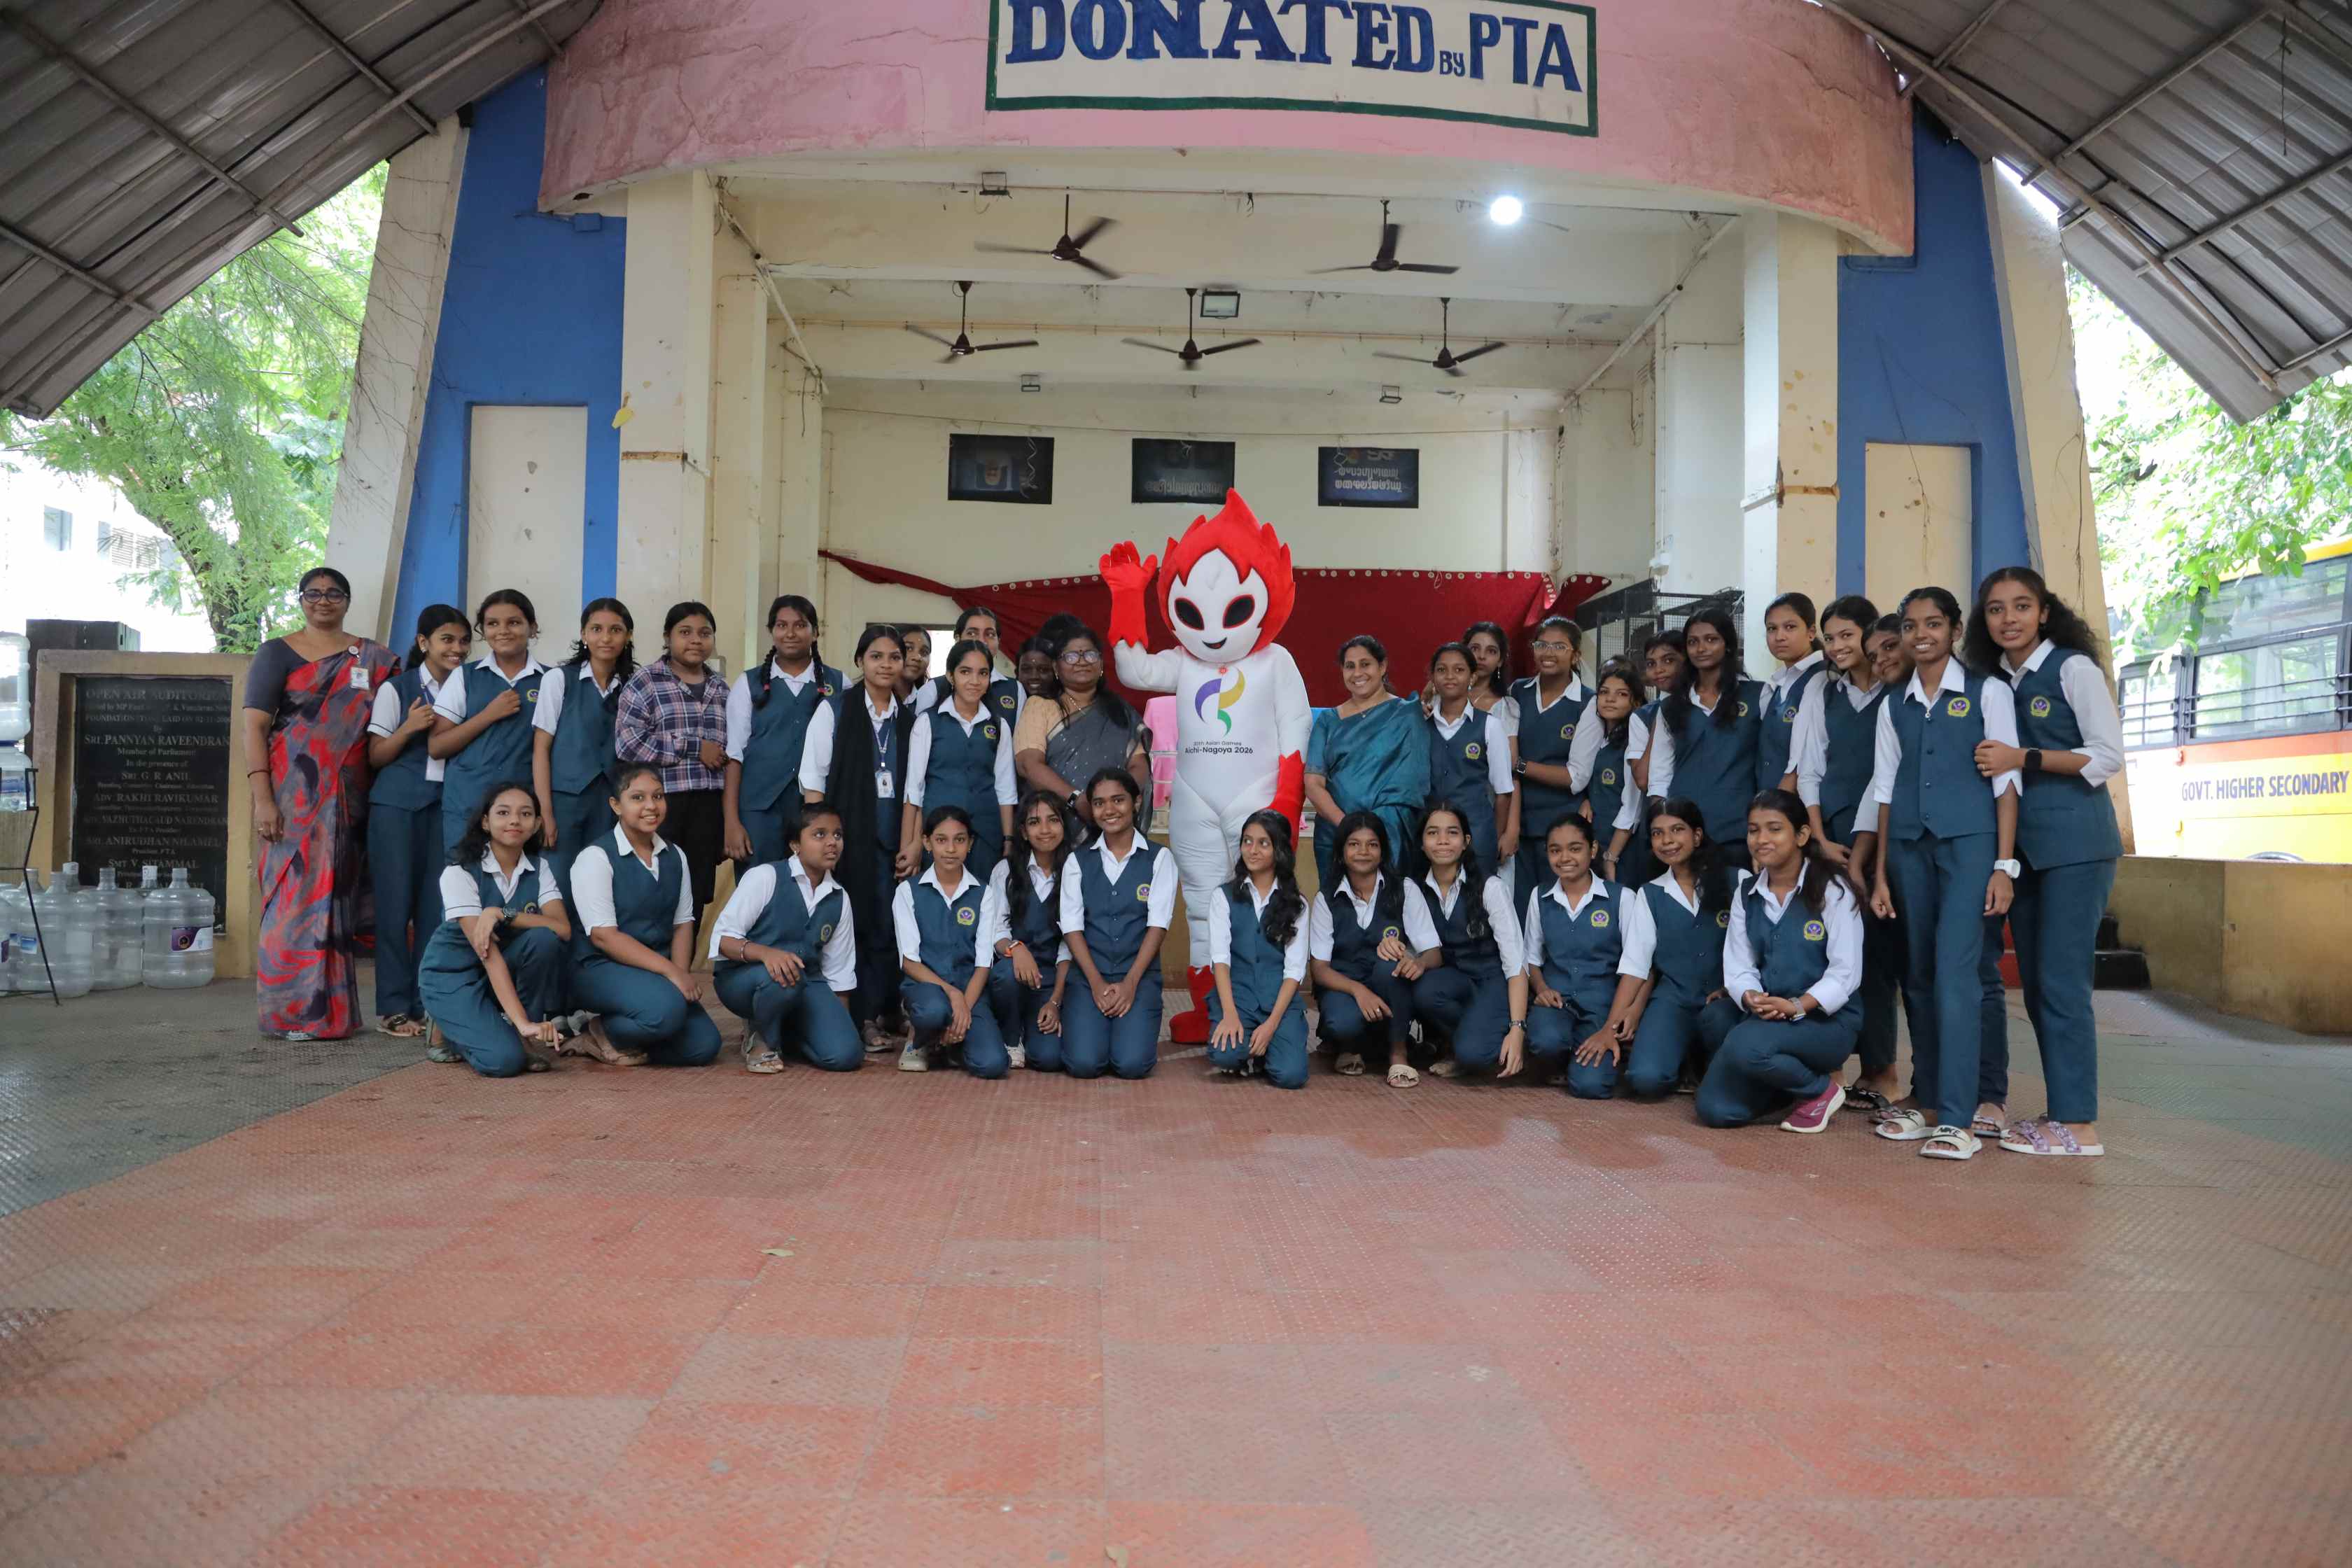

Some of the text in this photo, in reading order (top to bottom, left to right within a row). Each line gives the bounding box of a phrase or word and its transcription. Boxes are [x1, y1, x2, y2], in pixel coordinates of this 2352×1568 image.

[1006, 0, 1435, 73] DONATED
[1469, 13, 1583, 92] PTA
[1185, 746, 1232, 755] Aichi-Nagoya
[2182, 771, 2350, 802] GOVT. HIGHER SECONDARY
[1937, 1126, 1961, 1137] NIKE
